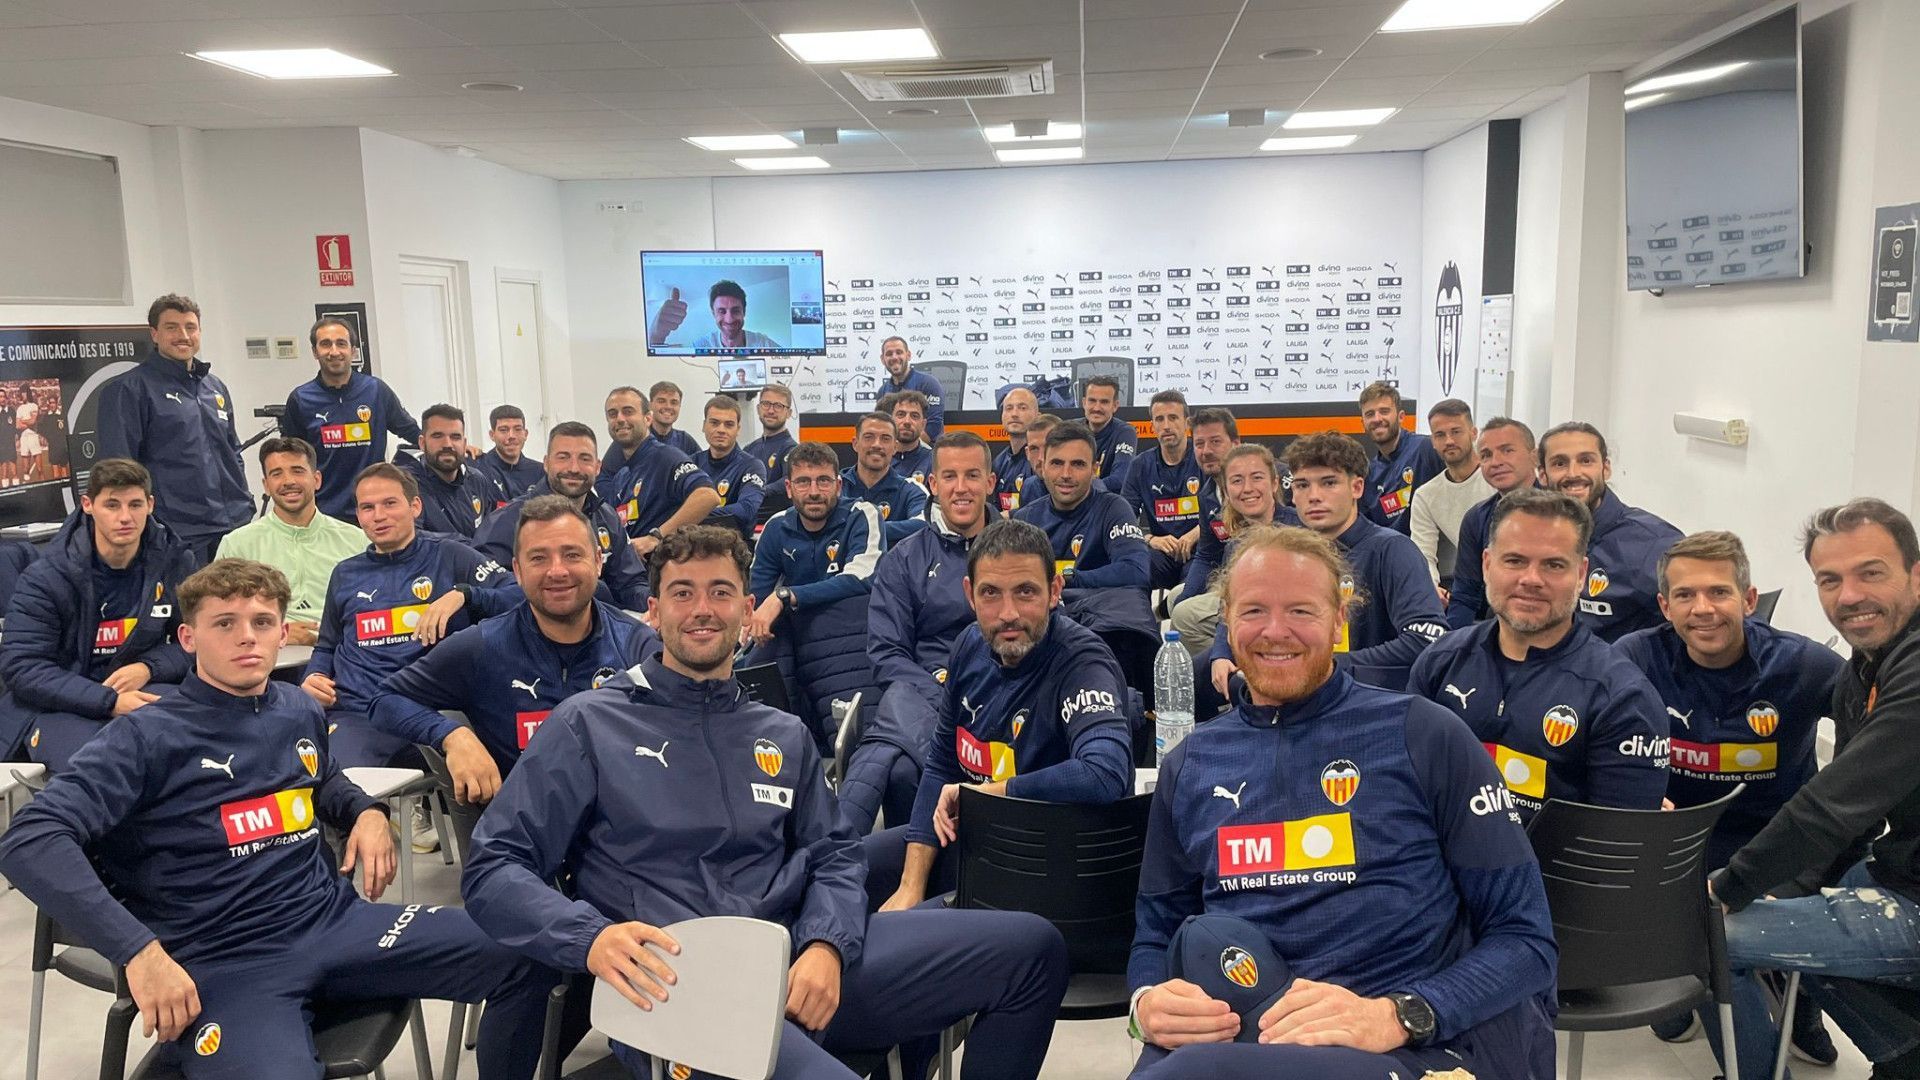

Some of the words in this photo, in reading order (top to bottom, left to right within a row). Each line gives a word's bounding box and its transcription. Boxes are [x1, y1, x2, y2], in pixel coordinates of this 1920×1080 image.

[321, 272, 352, 281] EXTINTOR
[8, 340, 77, 361] COMUNICACIÓ
[79, 343, 98, 358] DES
[99, 343, 112, 358] DE
[113, 342, 135, 357] 1919
[324, 430, 342, 440] TM
[1158, 503, 1175, 513] TM
[1109, 522, 1143, 540] divina
[361, 617, 386, 633] TM
[370, 637, 385, 646] Real
[387, 635, 409, 645] Estate
[1062, 689, 1115, 724] divina
[523, 721, 543, 741] T
[961, 737, 983, 768] TM
[1672, 746, 1709, 766] TM
[1684, 769, 1706, 780] Real
[1709, 773, 1741, 781] Estate
[1744, 772, 1776, 782] Group
[755, 788, 771, 800] TM
[229, 807, 273, 834] TM
[229, 845, 249, 857] TM
[1226, 837, 1272, 865] TM
[1220, 878, 1239, 892] TM
[1241, 874, 1266, 890] Real
[1270, 873, 1309, 886] Estate
[1312, 871, 1356, 884] Group
[378, 904, 423, 948] SKOD
